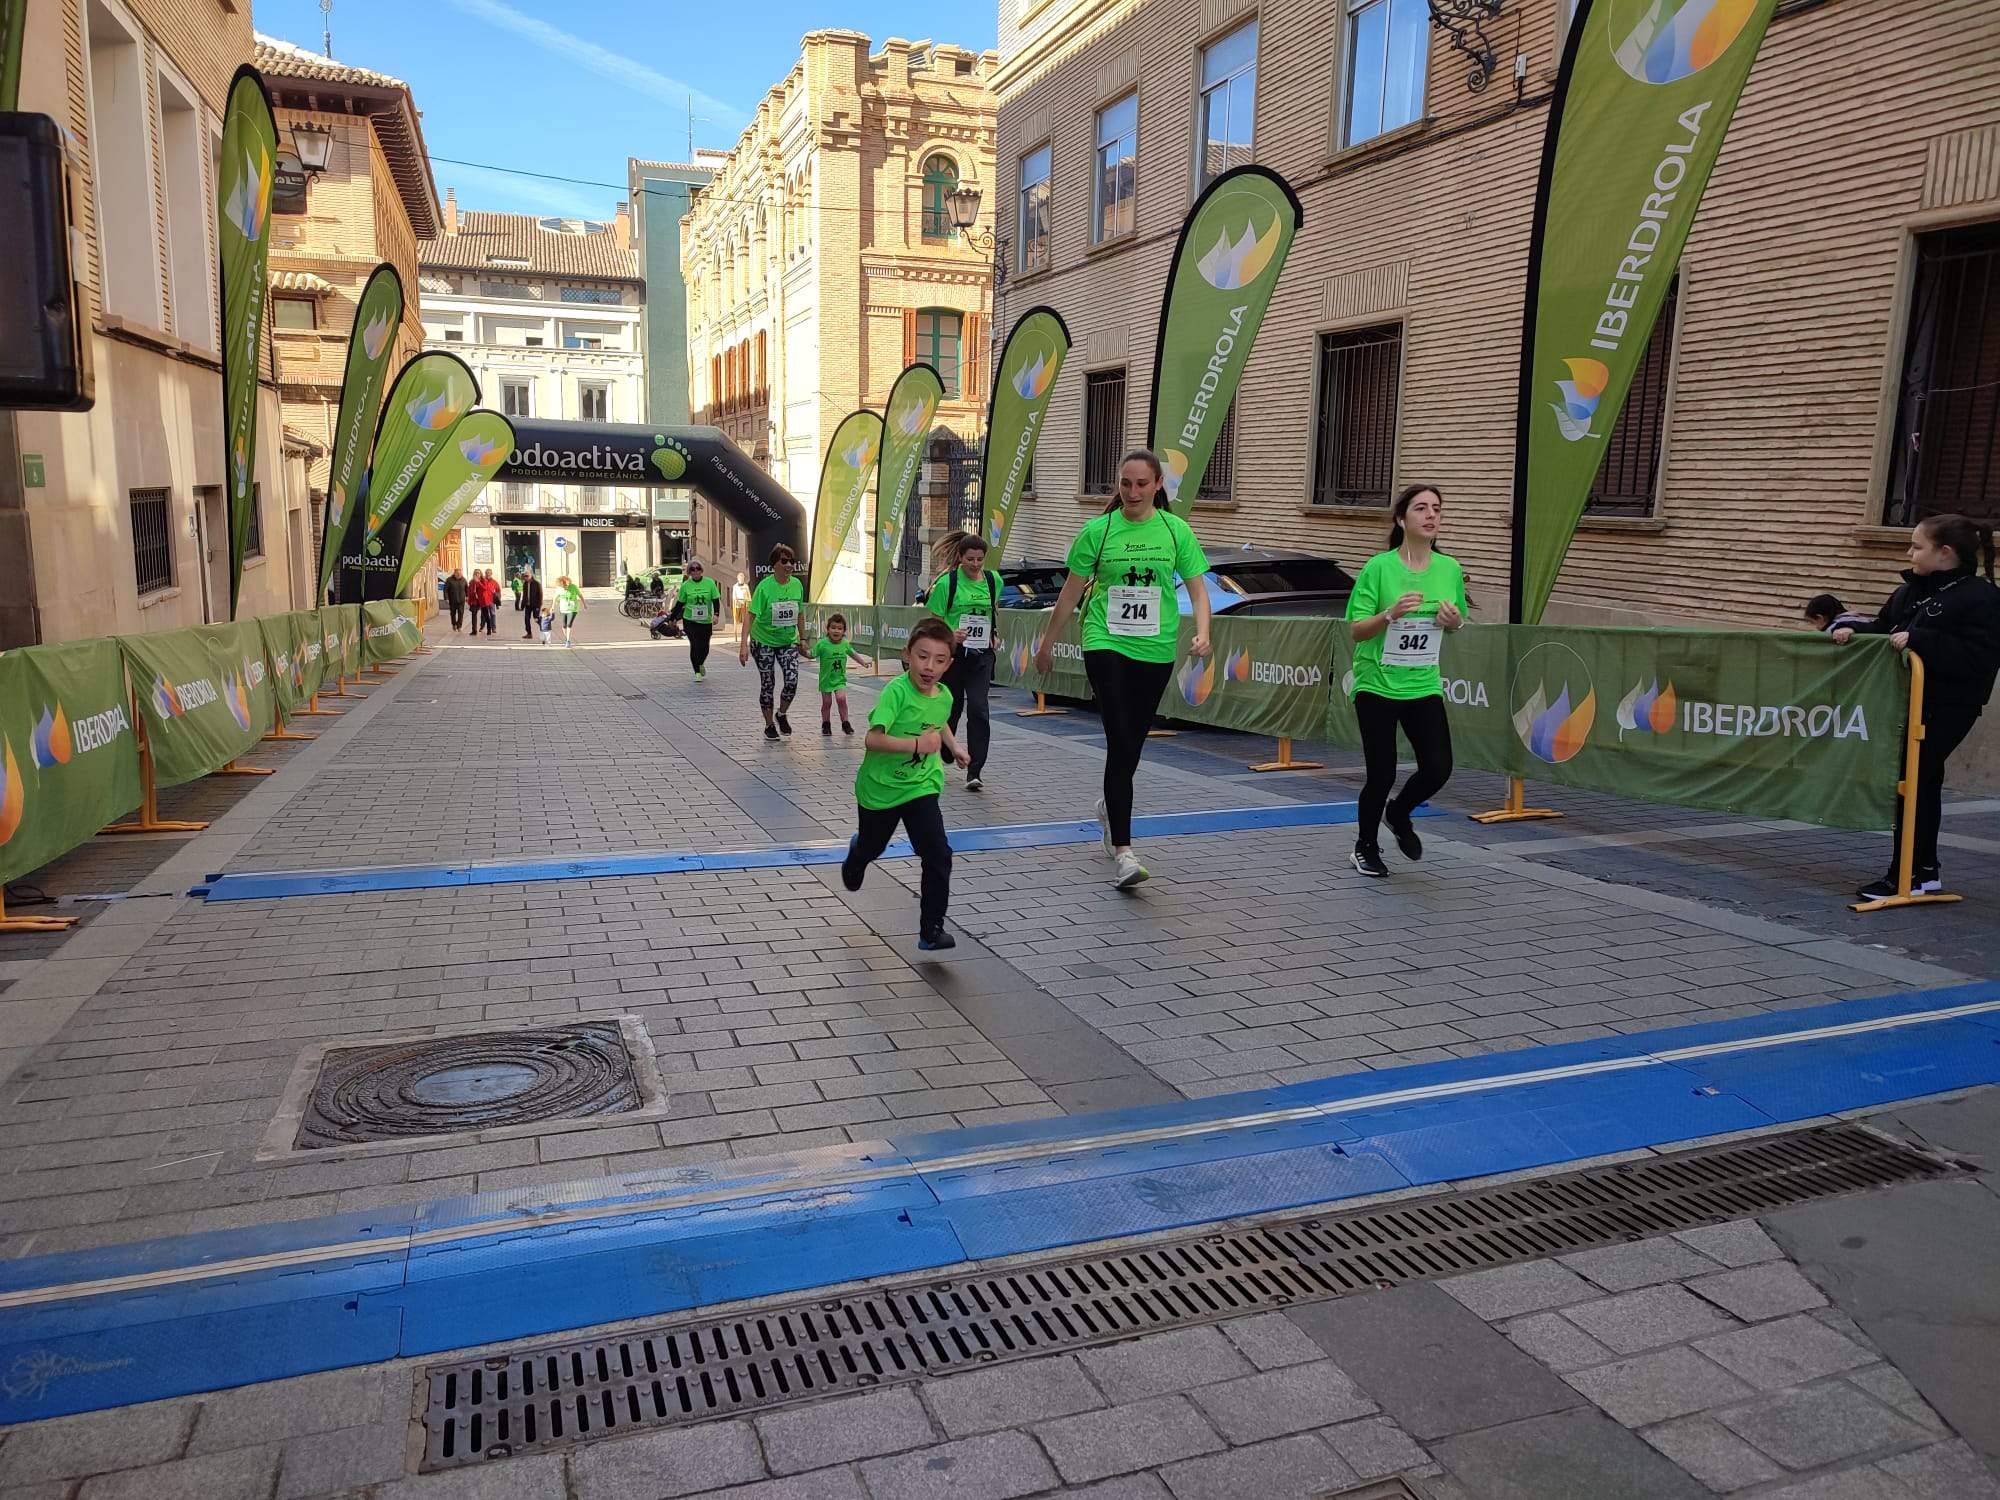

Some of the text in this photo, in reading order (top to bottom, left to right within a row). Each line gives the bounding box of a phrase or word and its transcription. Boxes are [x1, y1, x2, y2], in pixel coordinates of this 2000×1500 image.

[1590, 100, 1713, 351] IBERDROLA
[1178, 304, 1248, 449] IBERDROLA
[341, 375, 373, 485] IBERDROLA
[377, 440, 436, 516] IBERDROLA
[507, 442, 646, 471] odoactiva
[511, 468, 567, 477] PODOLOGÍA
[579, 471, 646, 480] BIOMECÁNICA
[1000, 411, 1040, 511] IBERDROLA
[430, 471, 483, 530] IBERDROLA
[710, 455, 782, 520] Pisa bien, vive mejor
[583, 518, 615, 527] INSIDE
[342, 553, 399, 569] podoactiv
[778, 609, 794, 619] 359
[1121, 603, 1147, 620] 214
[1399, 634, 1429, 650] 342
[72, 703, 130, 754] IBERDROA
[1682, 701, 1870, 741] IBERDROLA
